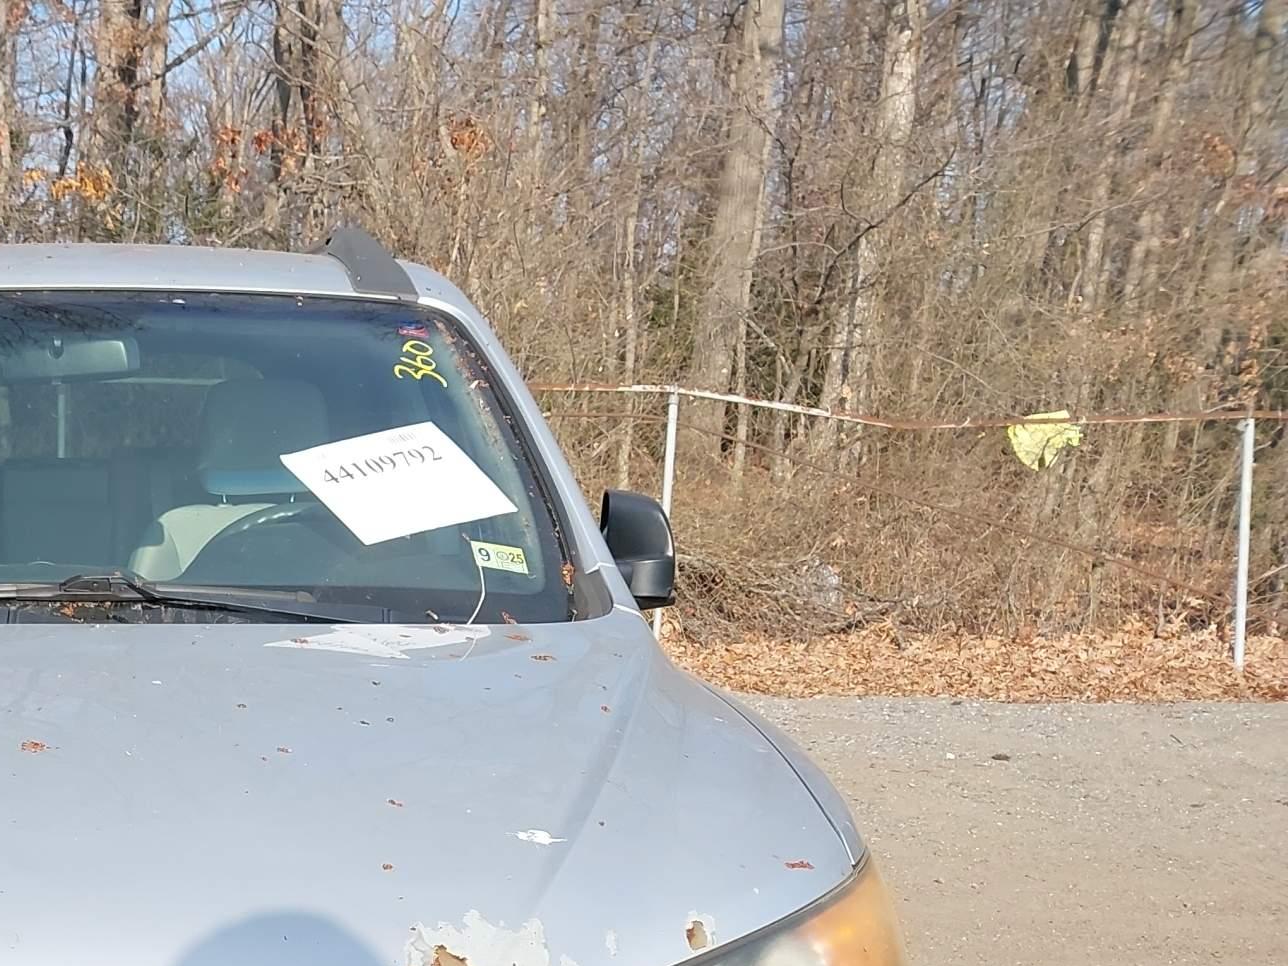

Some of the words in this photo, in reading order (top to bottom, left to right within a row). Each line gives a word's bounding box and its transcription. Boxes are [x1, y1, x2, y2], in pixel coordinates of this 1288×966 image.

[323, 445, 443, 484] 44109792
[478, 547, 491, 562] 9
[508, 552, 524, 565] 25
